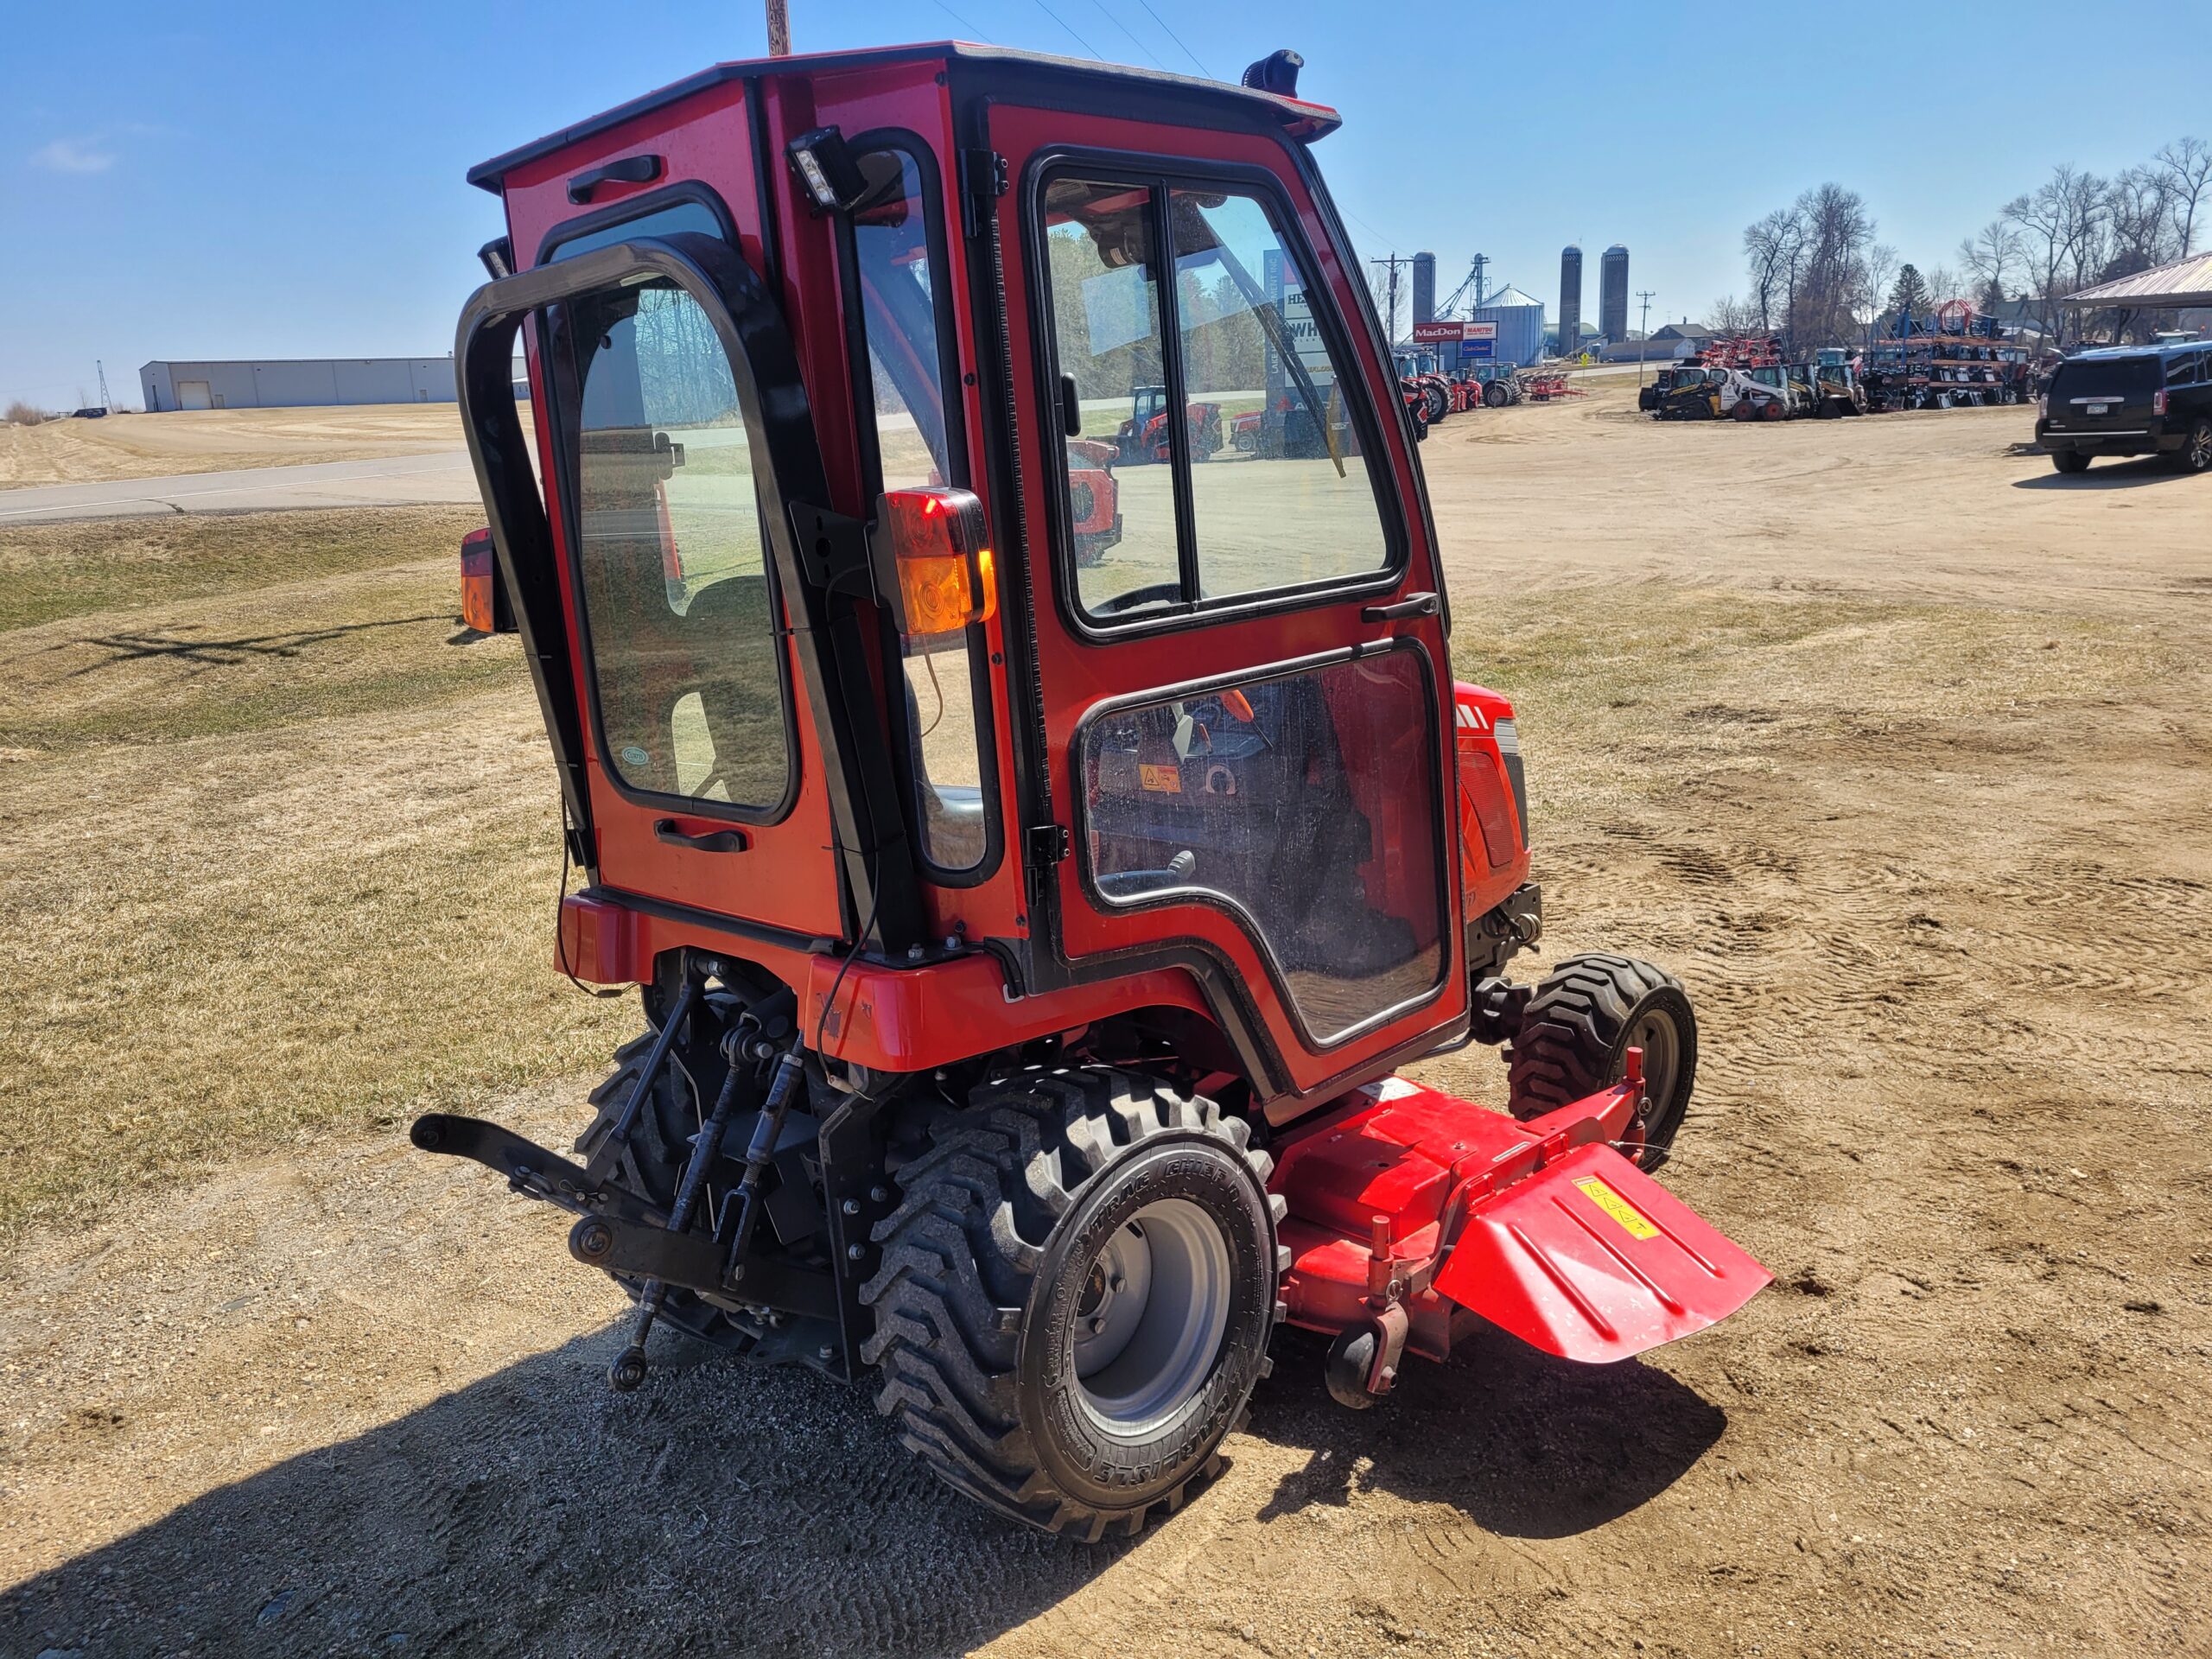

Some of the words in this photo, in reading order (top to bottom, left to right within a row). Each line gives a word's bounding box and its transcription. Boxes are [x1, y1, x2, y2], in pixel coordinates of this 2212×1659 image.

[1415, 327, 1461, 337] MacDon
[1090, 1170, 1151, 1233] TRAC
[1165, 1158, 1229, 1183] CHIEF
